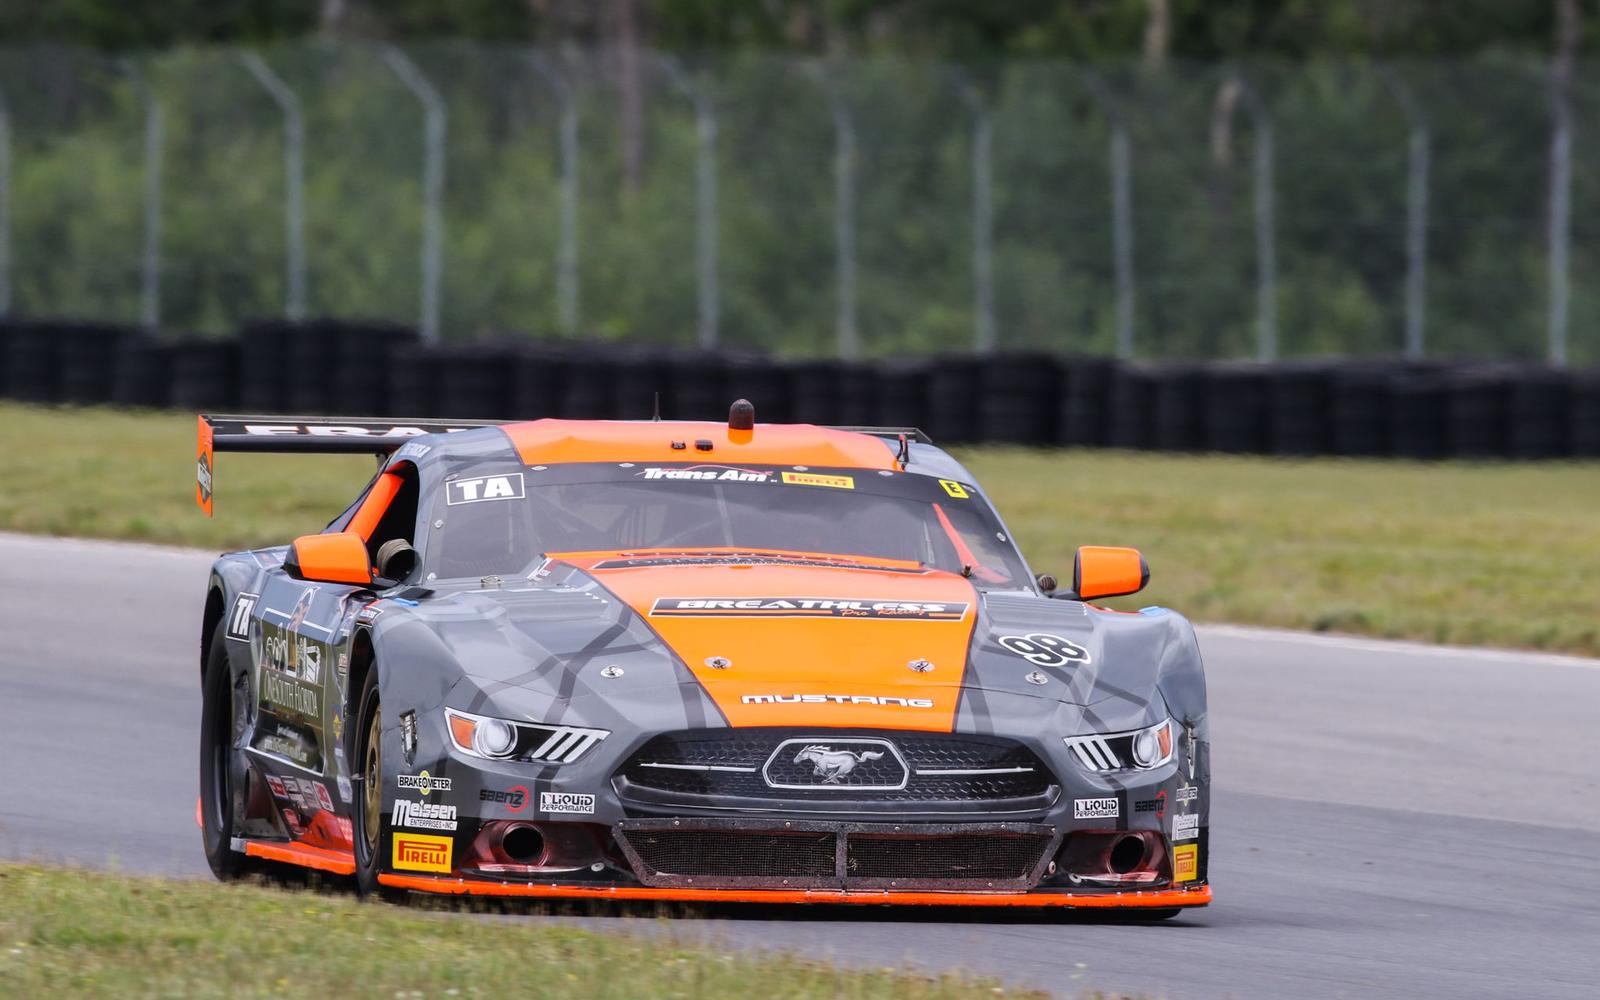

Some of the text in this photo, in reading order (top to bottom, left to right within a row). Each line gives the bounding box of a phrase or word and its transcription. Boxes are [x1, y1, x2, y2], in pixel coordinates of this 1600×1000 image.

[643, 467, 768, 483] Trans Am
[455, 477, 516, 501] TA
[231, 597, 256, 637] TA
[676, 598, 947, 612] BREATHLESS
[841, 608, 869, 617] Pro
[998, 633, 1092, 667] 98
[741, 693, 934, 708] MUSTANG
[391, 799, 457, 827] Meissen
[398, 840, 448, 865] PIRELLI
